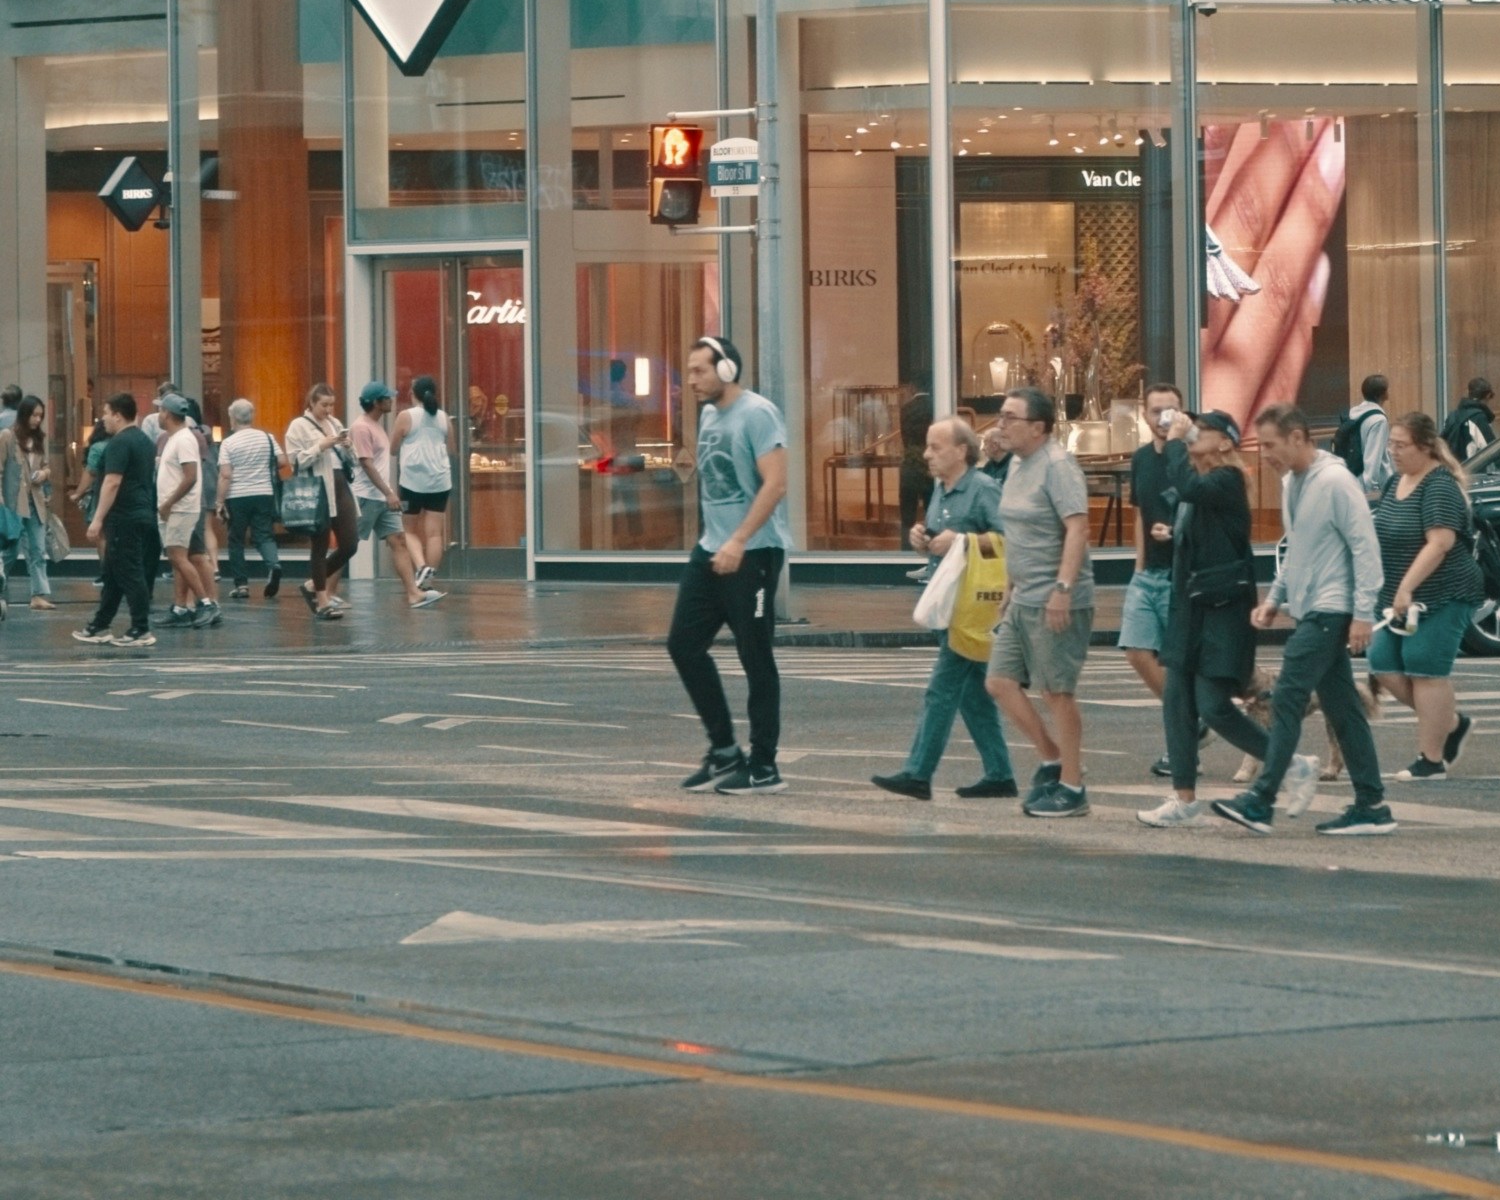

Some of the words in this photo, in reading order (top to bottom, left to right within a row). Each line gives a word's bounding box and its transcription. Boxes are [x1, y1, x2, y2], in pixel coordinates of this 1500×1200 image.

[1081, 170, 1112, 187] Van
[1115, 169, 1141, 187] Cle
[122, 188, 154, 200] BIRKS
[810, 269, 878, 287] BIRKS
[976, 591, 1004, 602] FRES
